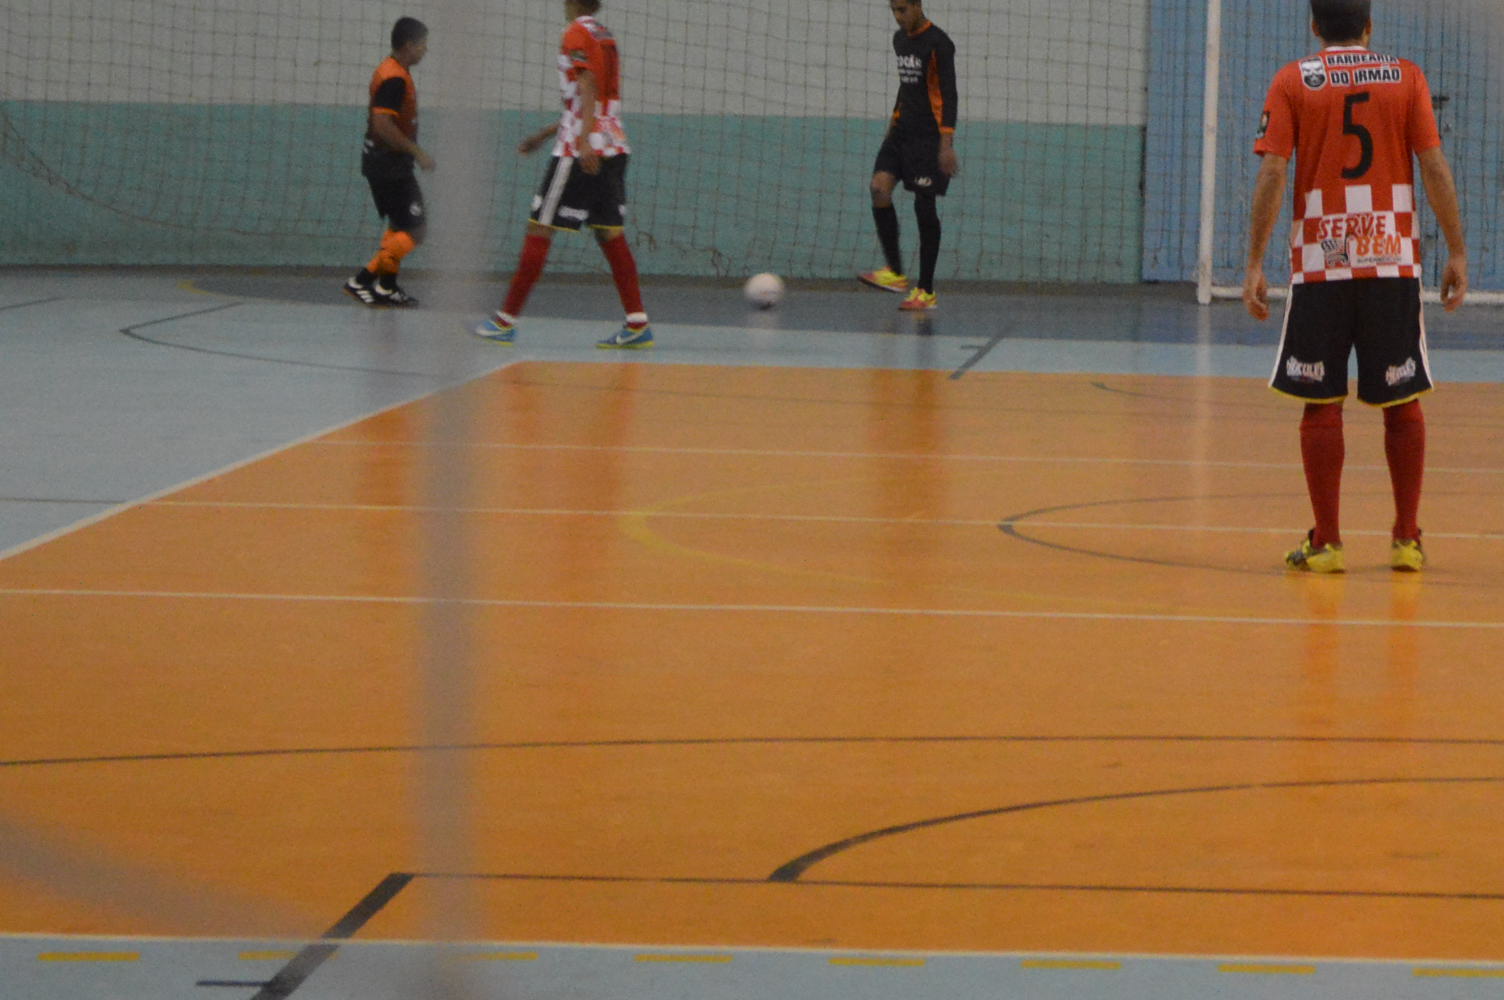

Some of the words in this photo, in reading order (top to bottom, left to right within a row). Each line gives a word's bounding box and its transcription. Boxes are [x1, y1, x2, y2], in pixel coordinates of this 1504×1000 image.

[1330, 70, 1350, 85] DO
[1353, 65, 1401, 84] IRMÃO
[1341, 91, 1374, 179] 5
[1317, 212, 1387, 240] SERVE
[1355, 234, 1402, 256] BEM
